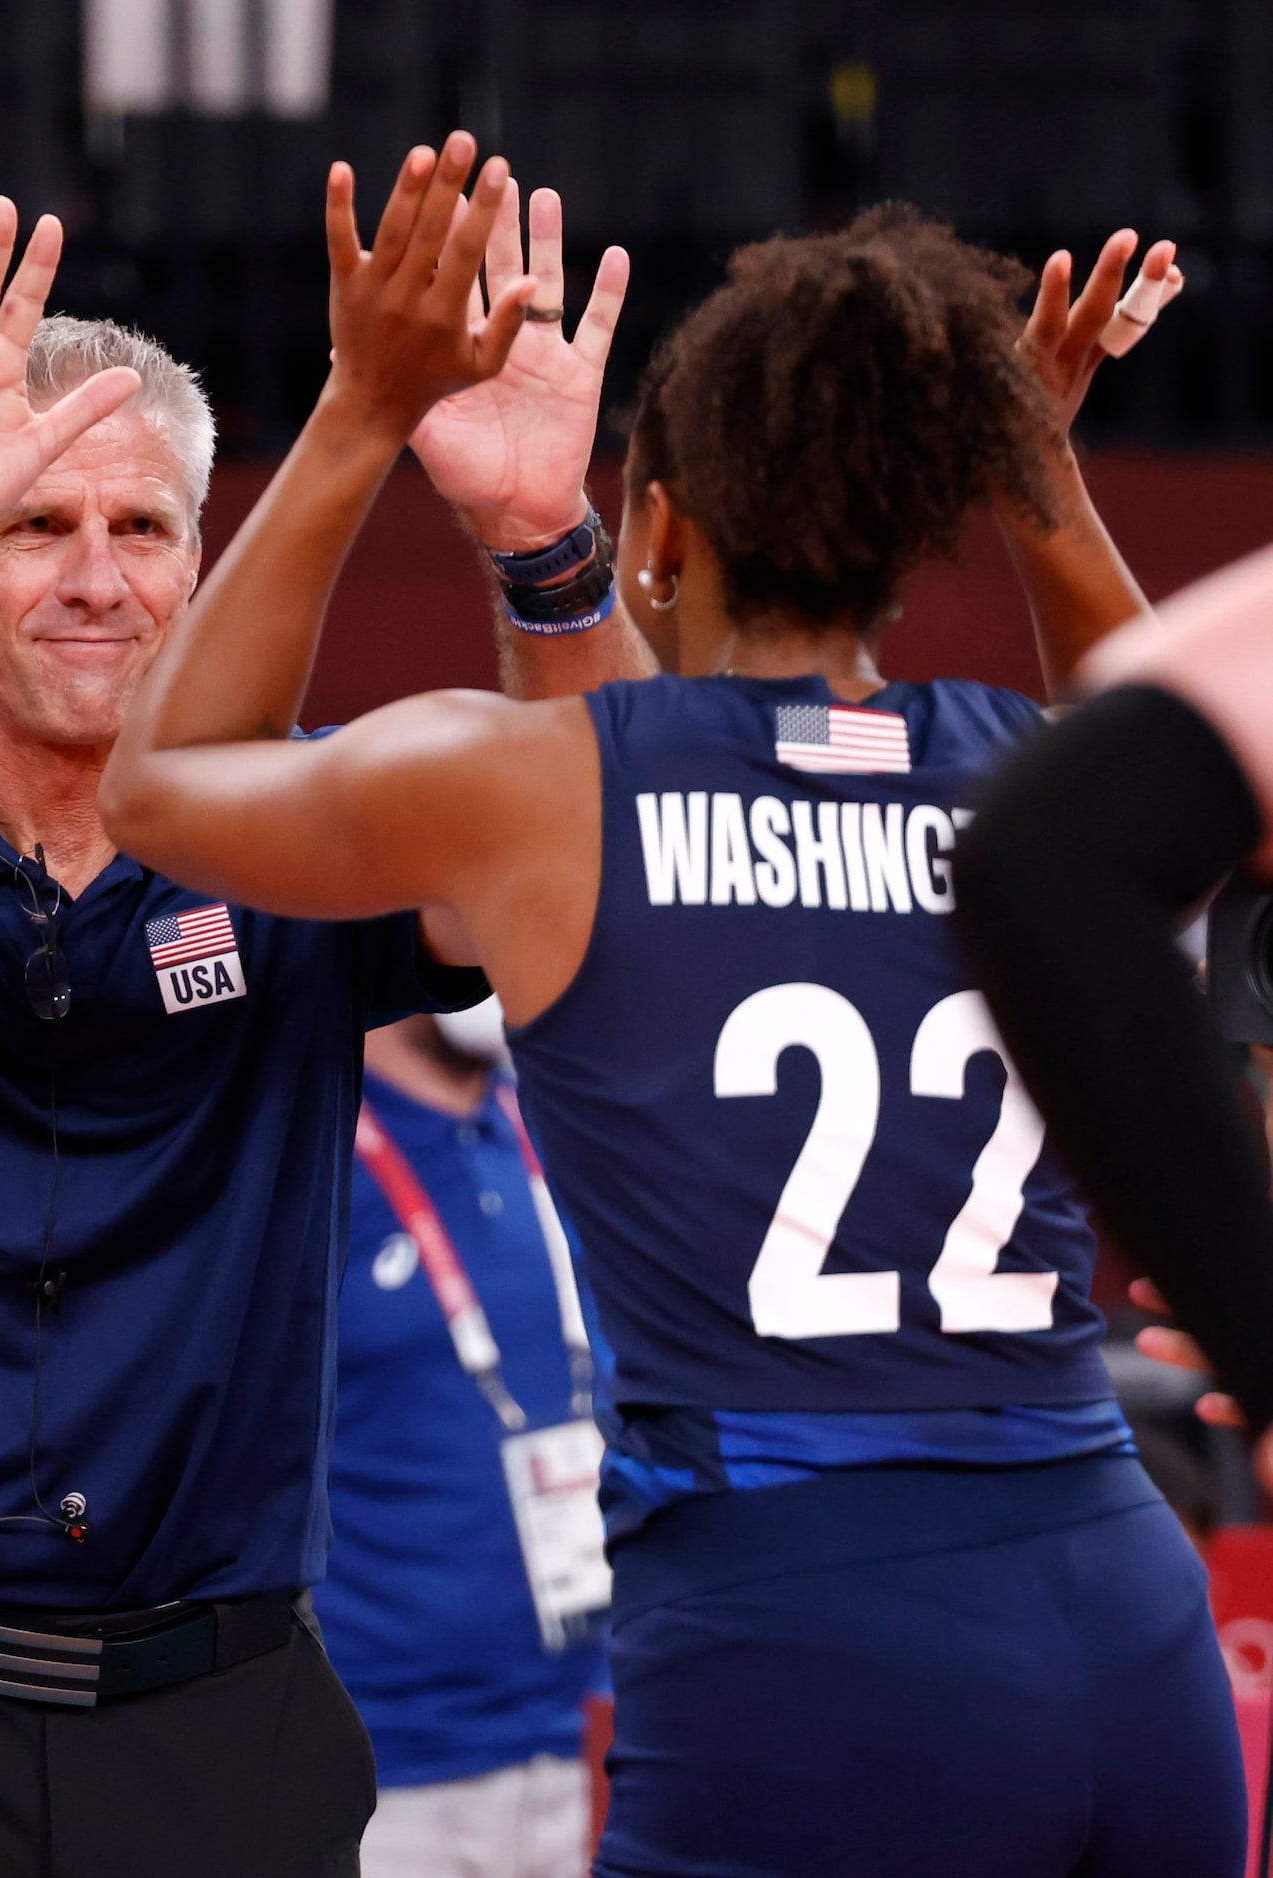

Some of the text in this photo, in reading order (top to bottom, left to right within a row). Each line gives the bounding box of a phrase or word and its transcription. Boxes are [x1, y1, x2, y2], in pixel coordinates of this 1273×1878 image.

[636, 792, 977, 915] WASHING
[170, 961, 236, 1004] USA
[713, 982, 1060, 1339] 22
